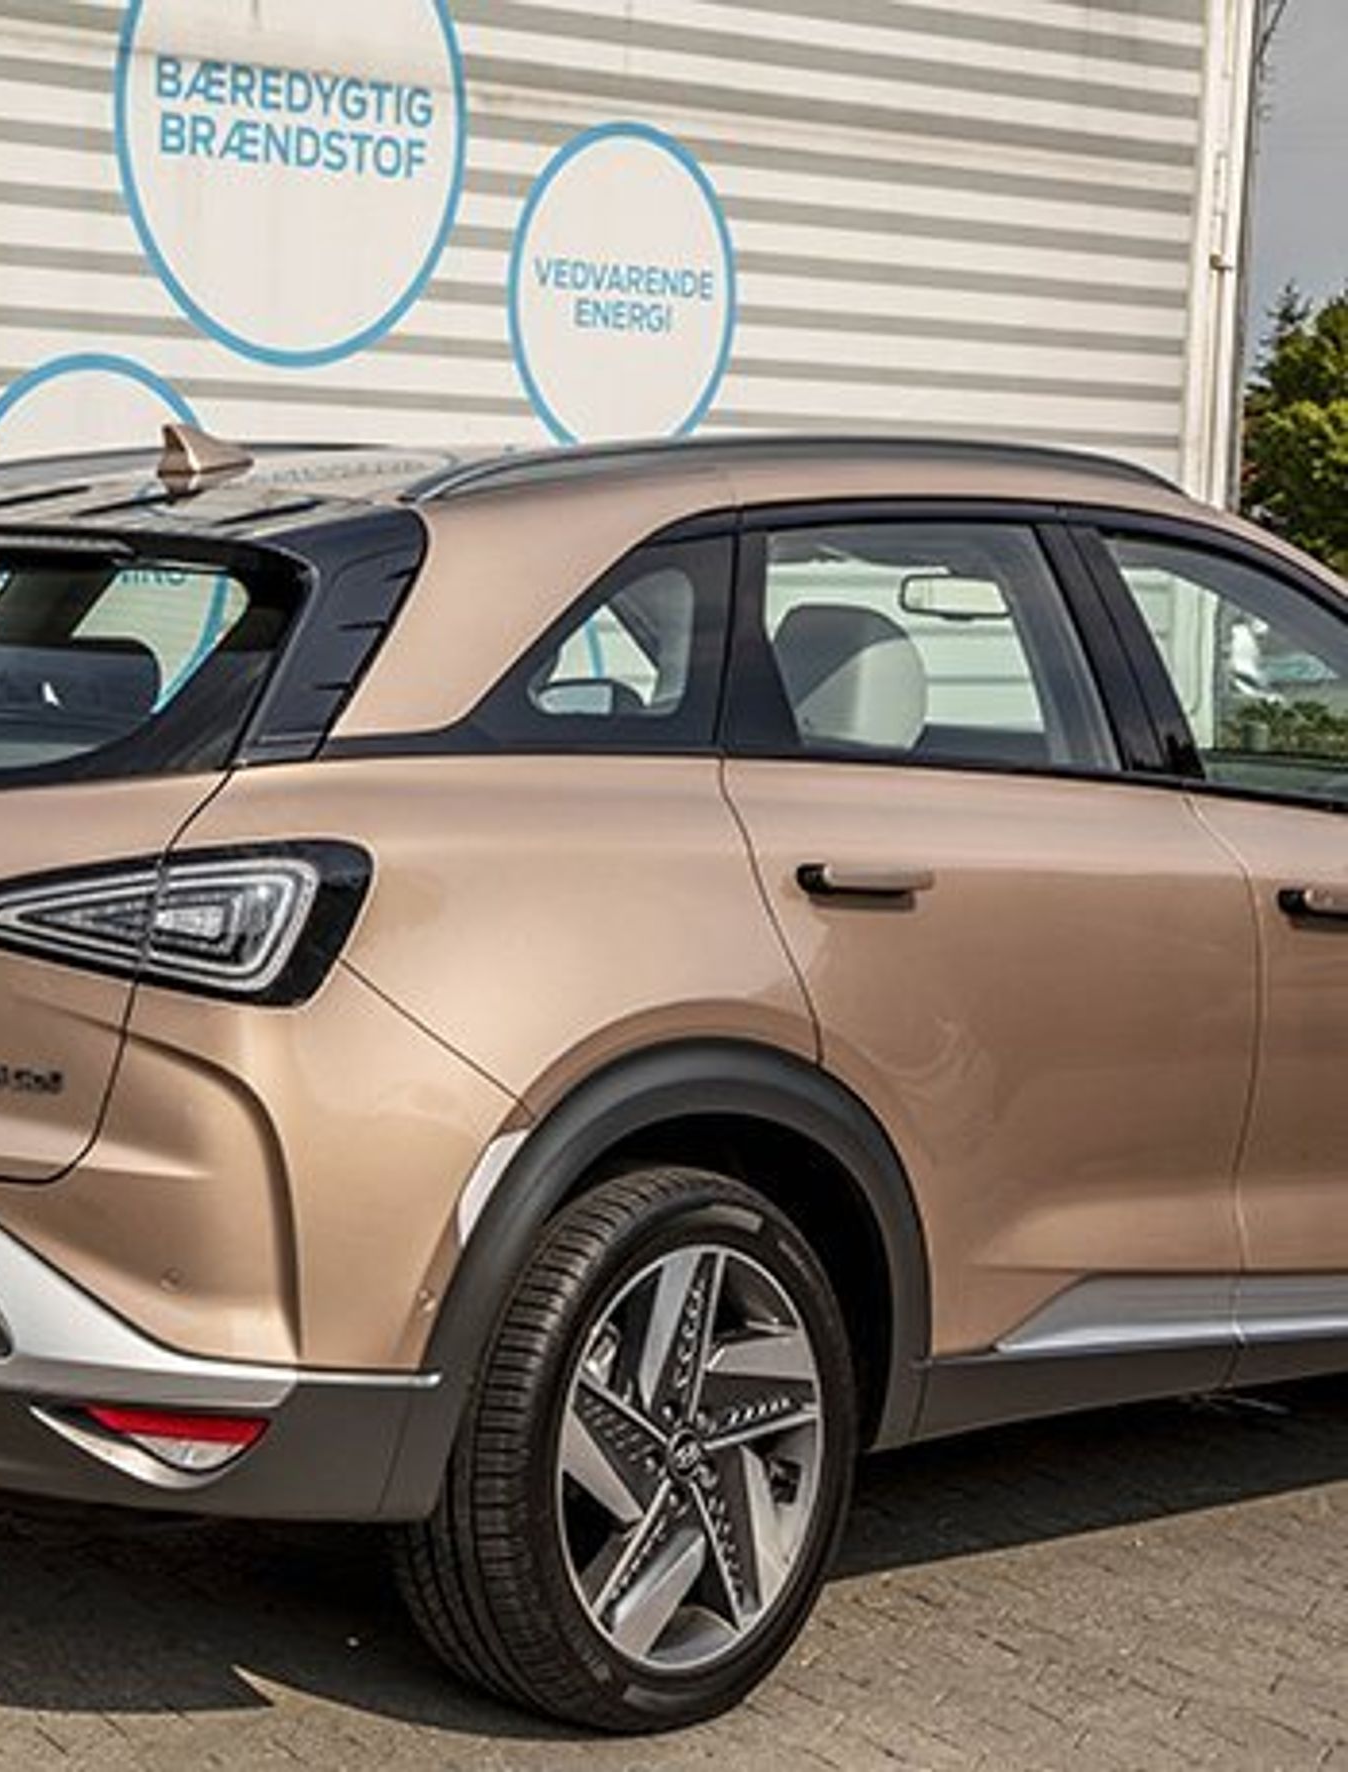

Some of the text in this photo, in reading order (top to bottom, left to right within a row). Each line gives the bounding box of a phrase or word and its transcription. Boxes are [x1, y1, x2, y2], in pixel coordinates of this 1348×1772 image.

[155, 55, 434, 129] BÆREDYGTIG
[159, 111, 427, 179] BRÆNDSTOF
[534, 257, 714, 300] VEDVARENDE
[574, 299, 671, 334] ENERGI
